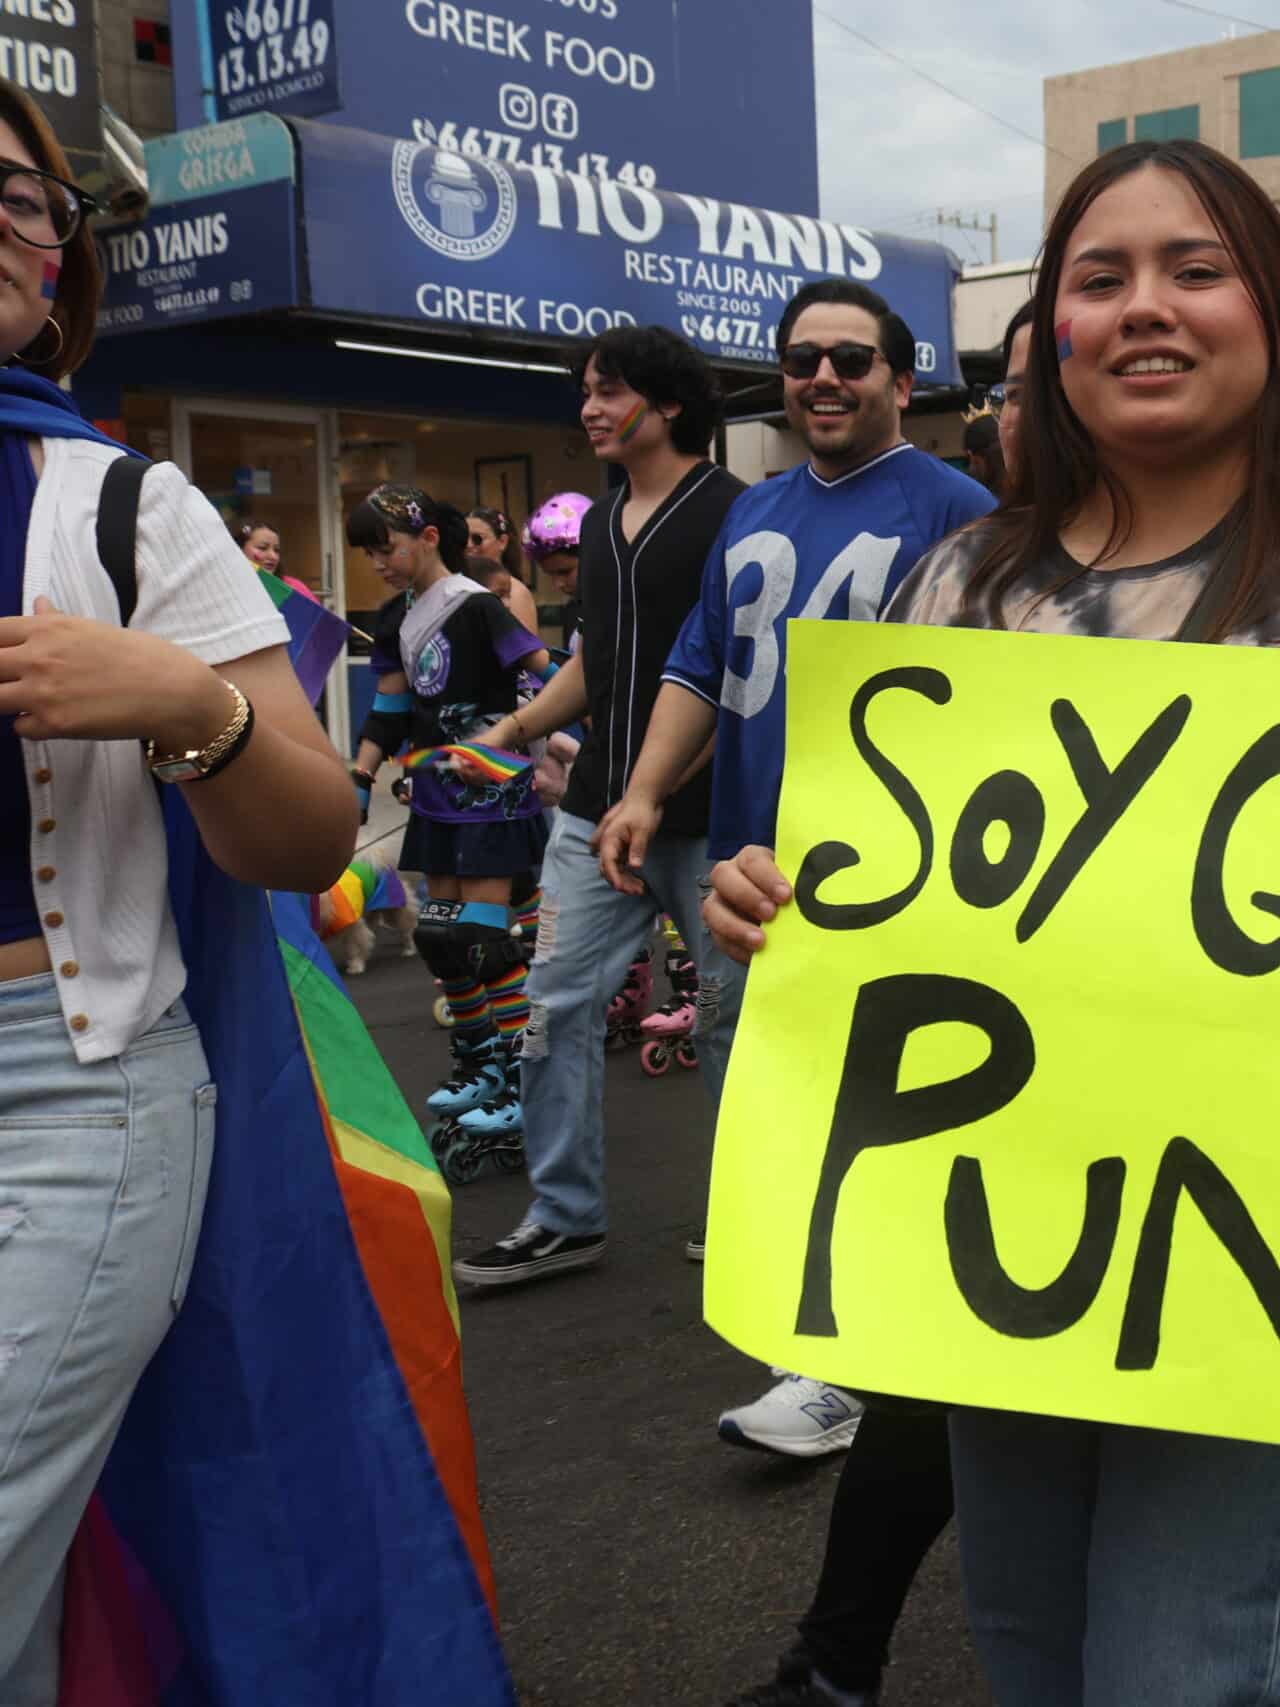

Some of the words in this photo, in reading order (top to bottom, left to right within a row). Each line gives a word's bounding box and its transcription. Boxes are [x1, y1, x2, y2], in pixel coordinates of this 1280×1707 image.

[218, 20, 329, 95] 13.13.49
[405, 0, 531, 62] GREEK
[544, 31, 655, 91] FOOD
[438, 121, 656, 188] 6677131349
[108, 229, 150, 273] TIO
[153, 211, 230, 265] YANIS
[514, 158, 664, 243] TIO
[676, 191, 882, 280] YANIS
[416, 283, 527, 330] GREEK
[624, 250, 804, 301] RESTAURANT
[677, 291, 716, 311] SINCE
[720, 297, 761, 317] 2005
[700, 314, 779, 351] 6677.1
[794, 666, 1192, 943] SOY
